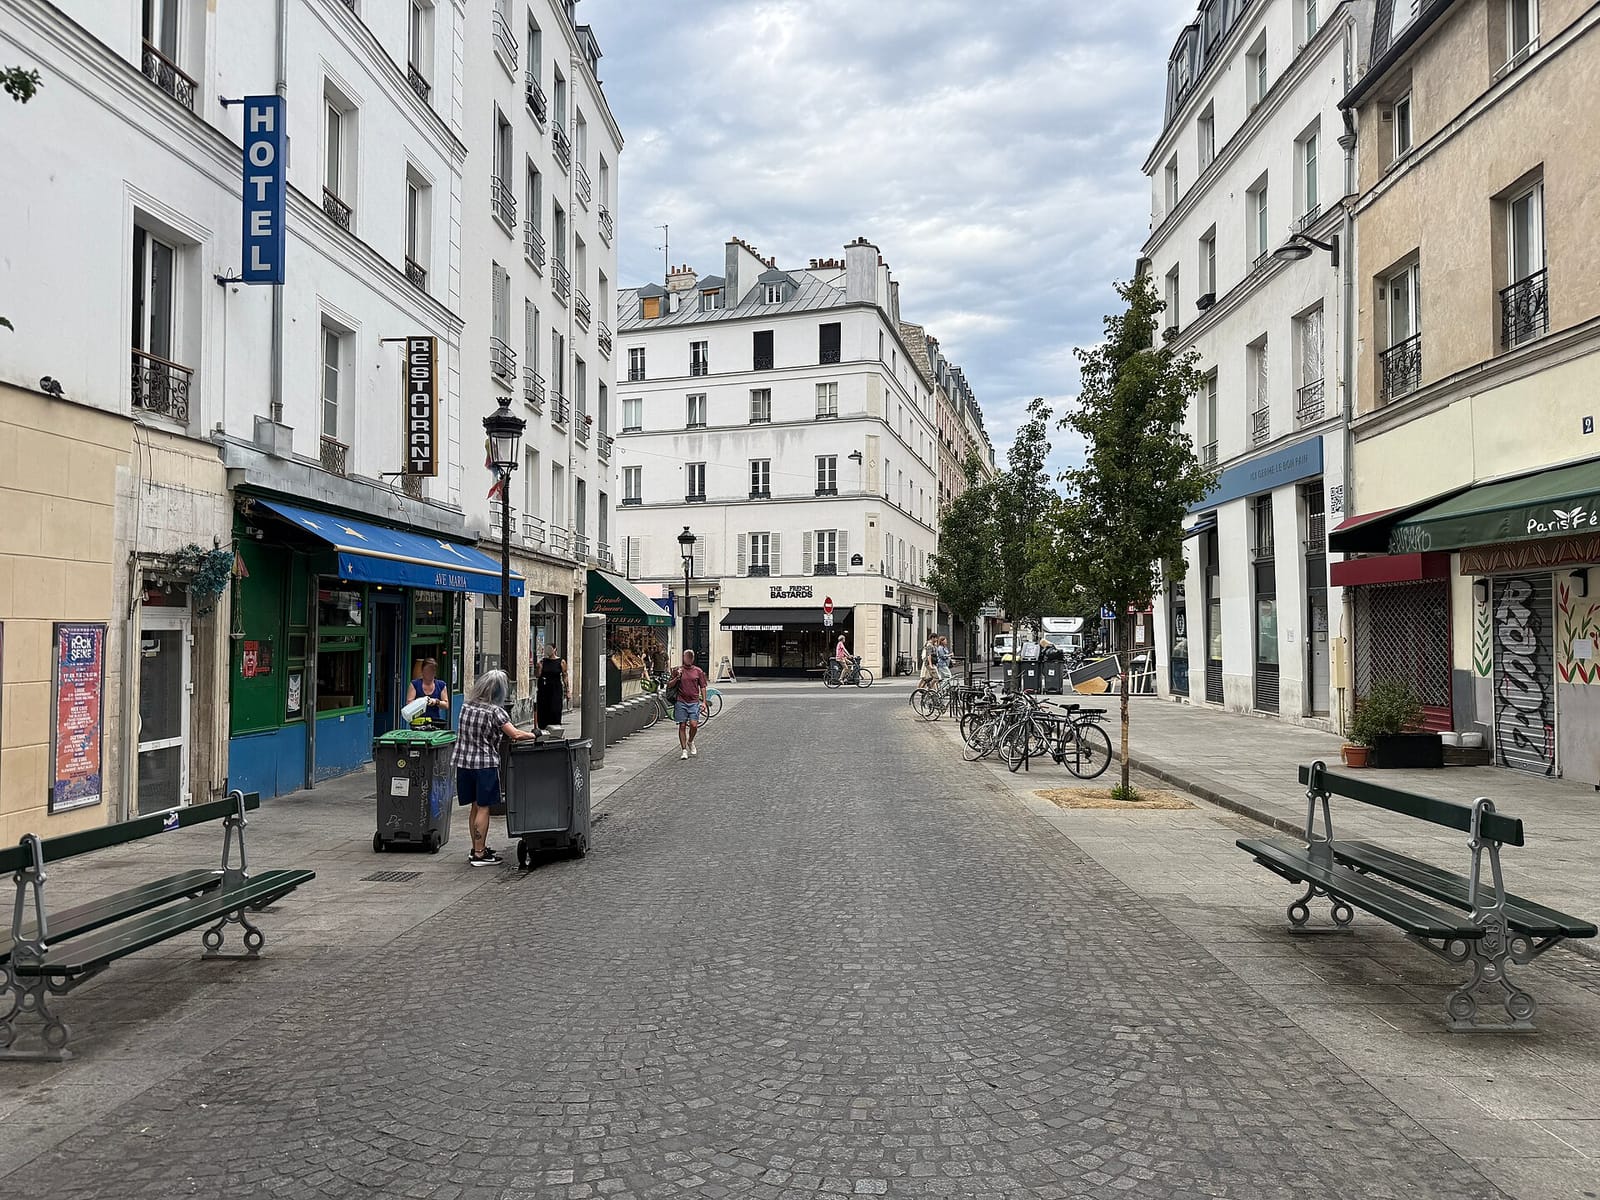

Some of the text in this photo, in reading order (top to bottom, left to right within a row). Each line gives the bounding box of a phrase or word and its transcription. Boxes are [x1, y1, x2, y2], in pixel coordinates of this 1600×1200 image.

[248, 106, 276, 272] HOTEL
[410, 339, 430, 472] RESTAURANT
[1585, 418, 1592, 433] 2
[435, 573, 467, 590] AVE MARIA
[770, 591, 813, 599] BASTARDS
[71, 635, 92, 649] ROCK
[71, 648, 92, 661] SEINE
